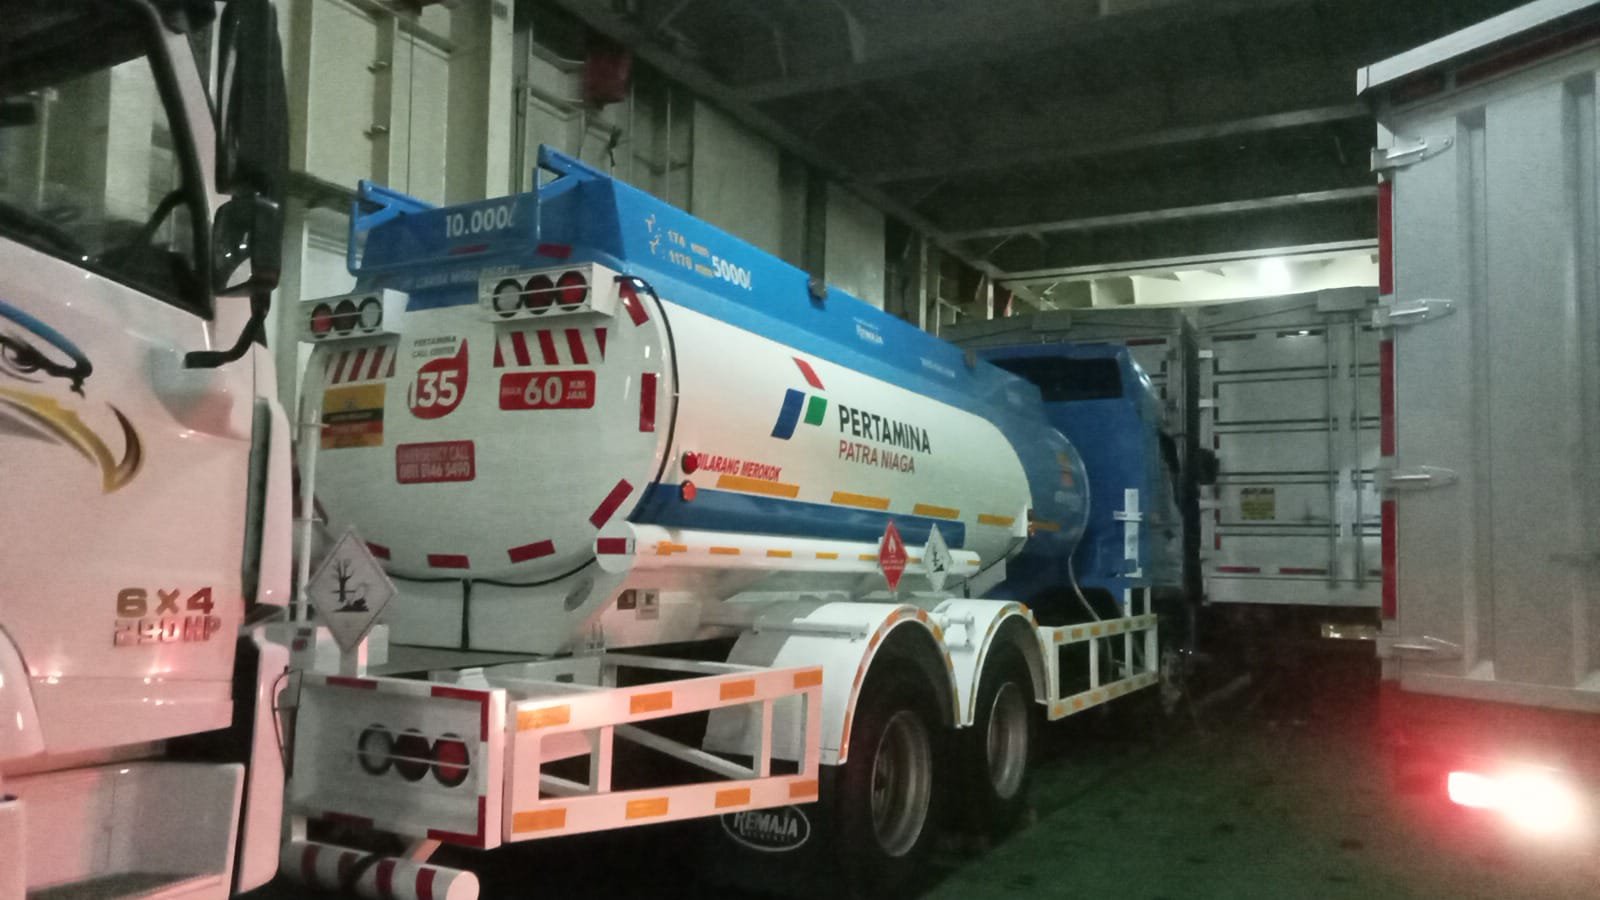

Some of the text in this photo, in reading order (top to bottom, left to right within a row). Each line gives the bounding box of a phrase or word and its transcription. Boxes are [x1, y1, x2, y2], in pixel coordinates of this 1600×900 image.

[409, 369, 459, 408] 135
[523, 375, 563, 406] 60
[838, 403, 932, 454] PERTAMINA
[697, 452, 782, 481] DILARANG MEROKOK
[838, 439, 915, 475] PATRA NIAGA
[734, 809, 798, 837] REMAJA
